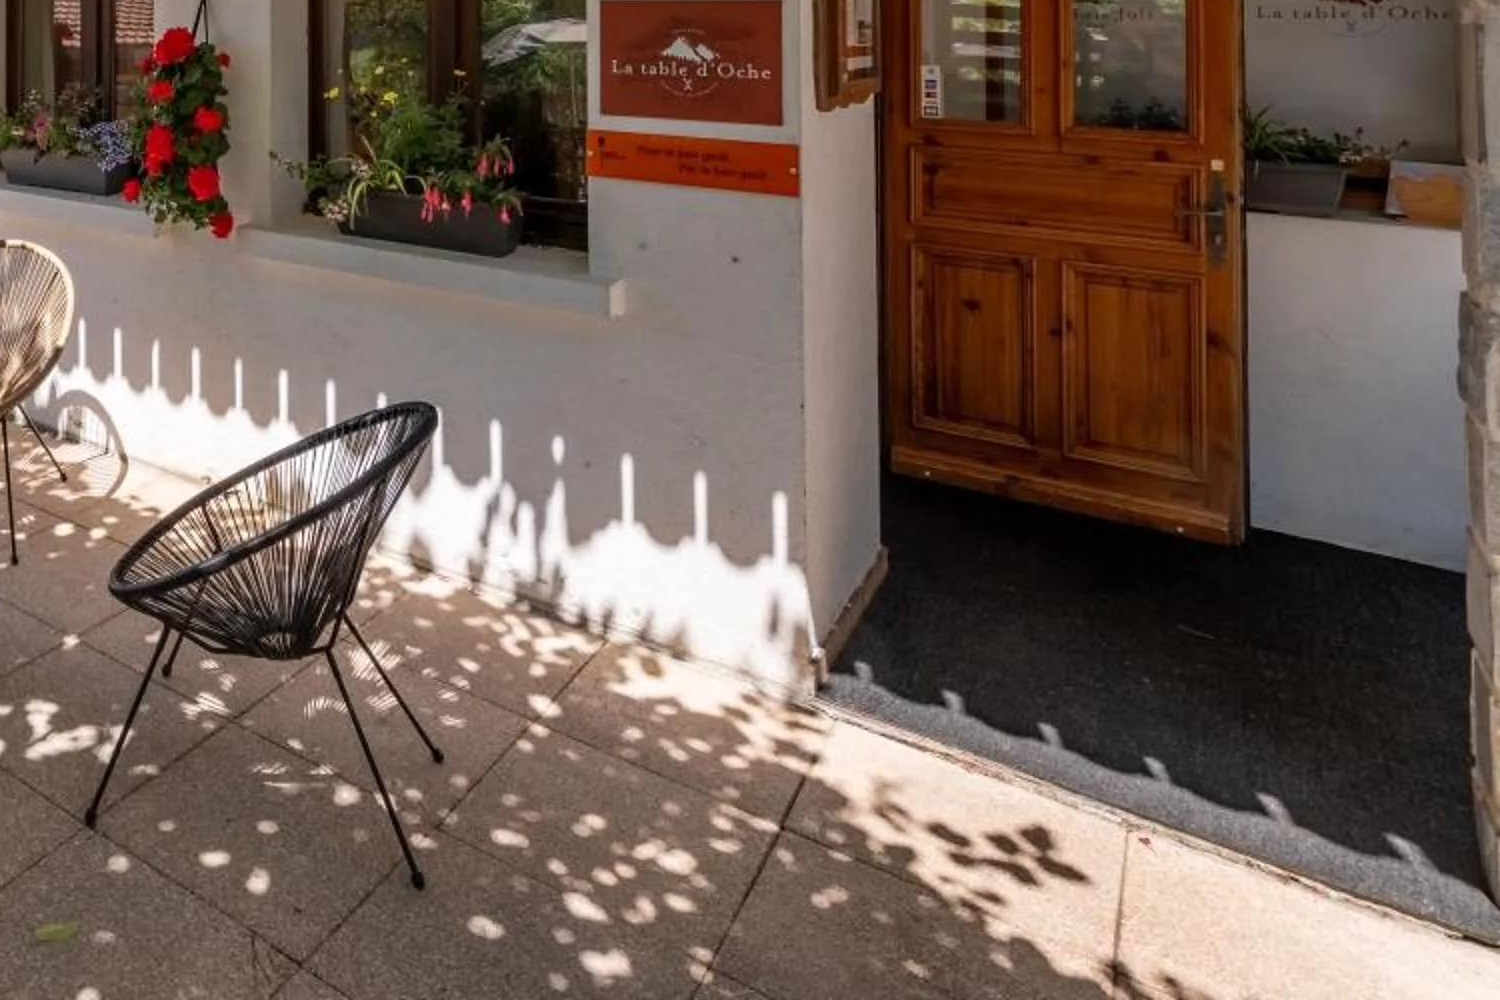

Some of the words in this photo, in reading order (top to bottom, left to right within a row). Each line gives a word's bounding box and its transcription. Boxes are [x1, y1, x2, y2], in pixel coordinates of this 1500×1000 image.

[1256, 5, 1283, 19] La
[1293, 5, 1350, 19] table
[611, 59, 633, 75] La
[641, 61, 688, 77] table
[697, 61, 771, 80] d'Oche
